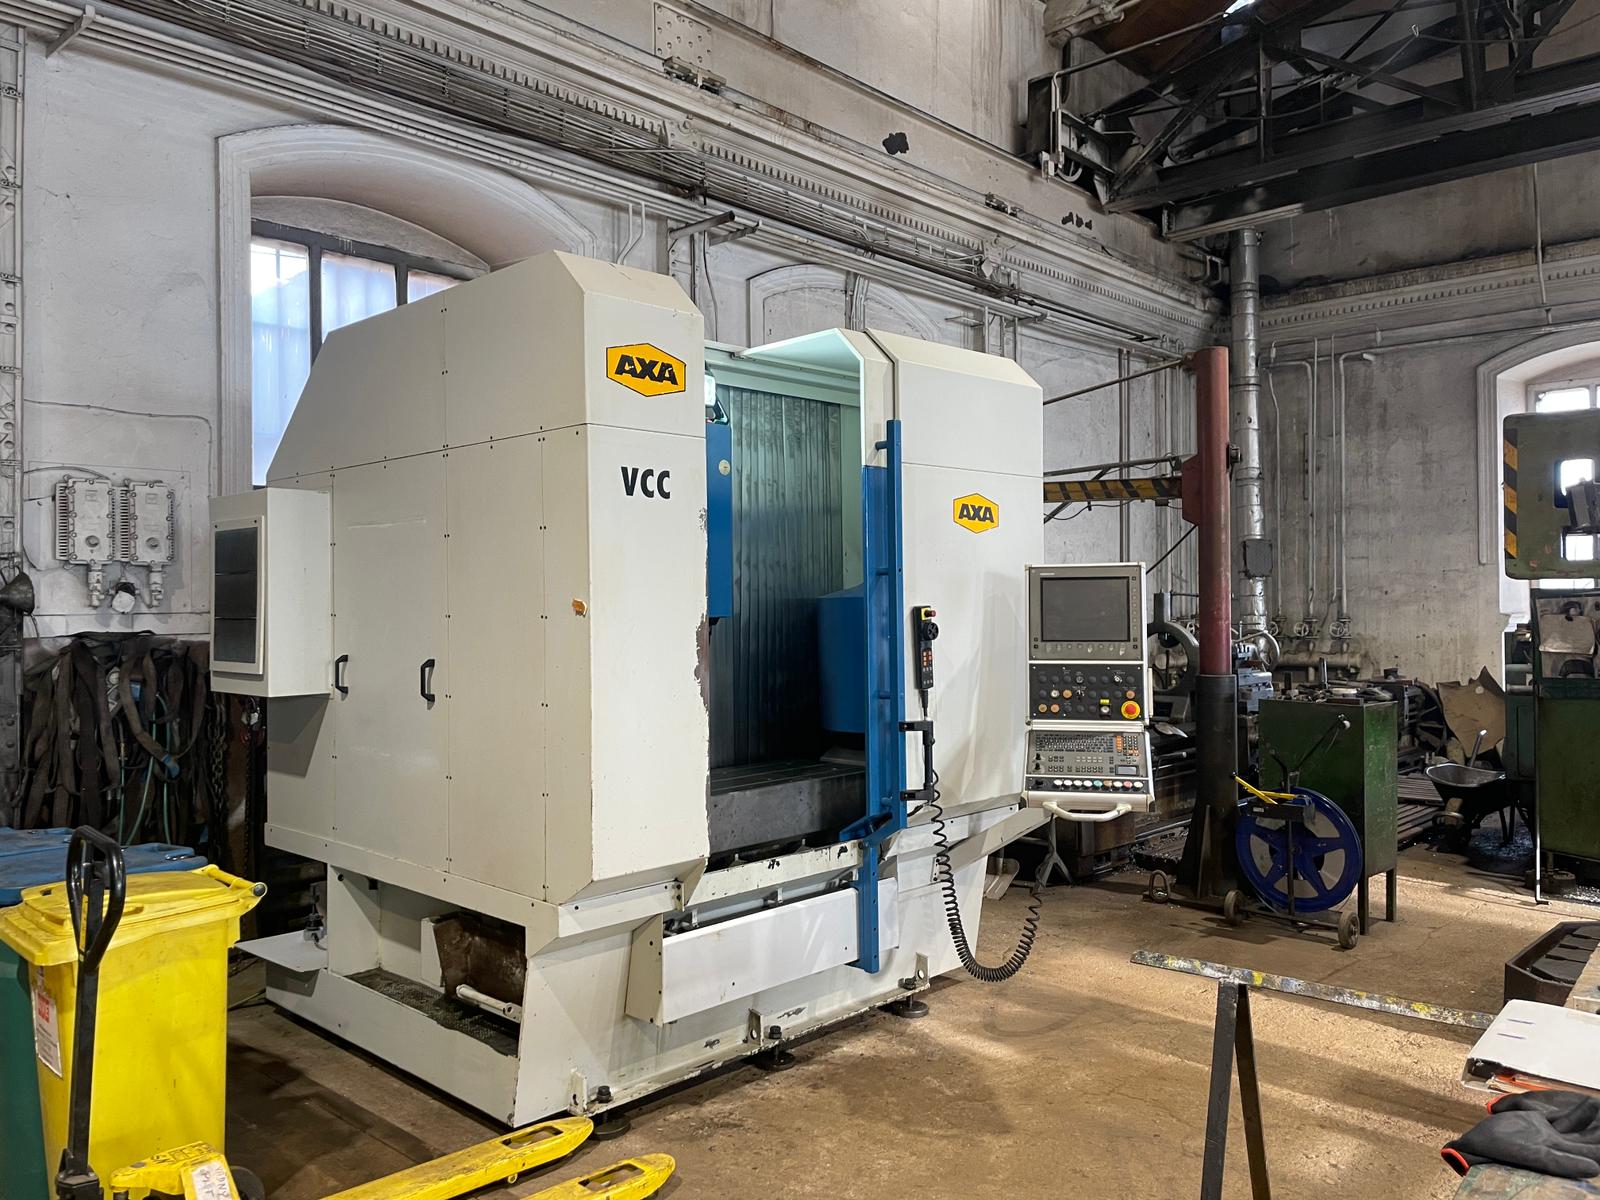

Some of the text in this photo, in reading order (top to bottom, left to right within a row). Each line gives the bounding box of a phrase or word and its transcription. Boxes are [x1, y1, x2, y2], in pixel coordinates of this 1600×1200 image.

[615, 354, 678, 385] AXA
[621, 466, 671, 499] VCC
[958, 503, 995, 523] AXA
